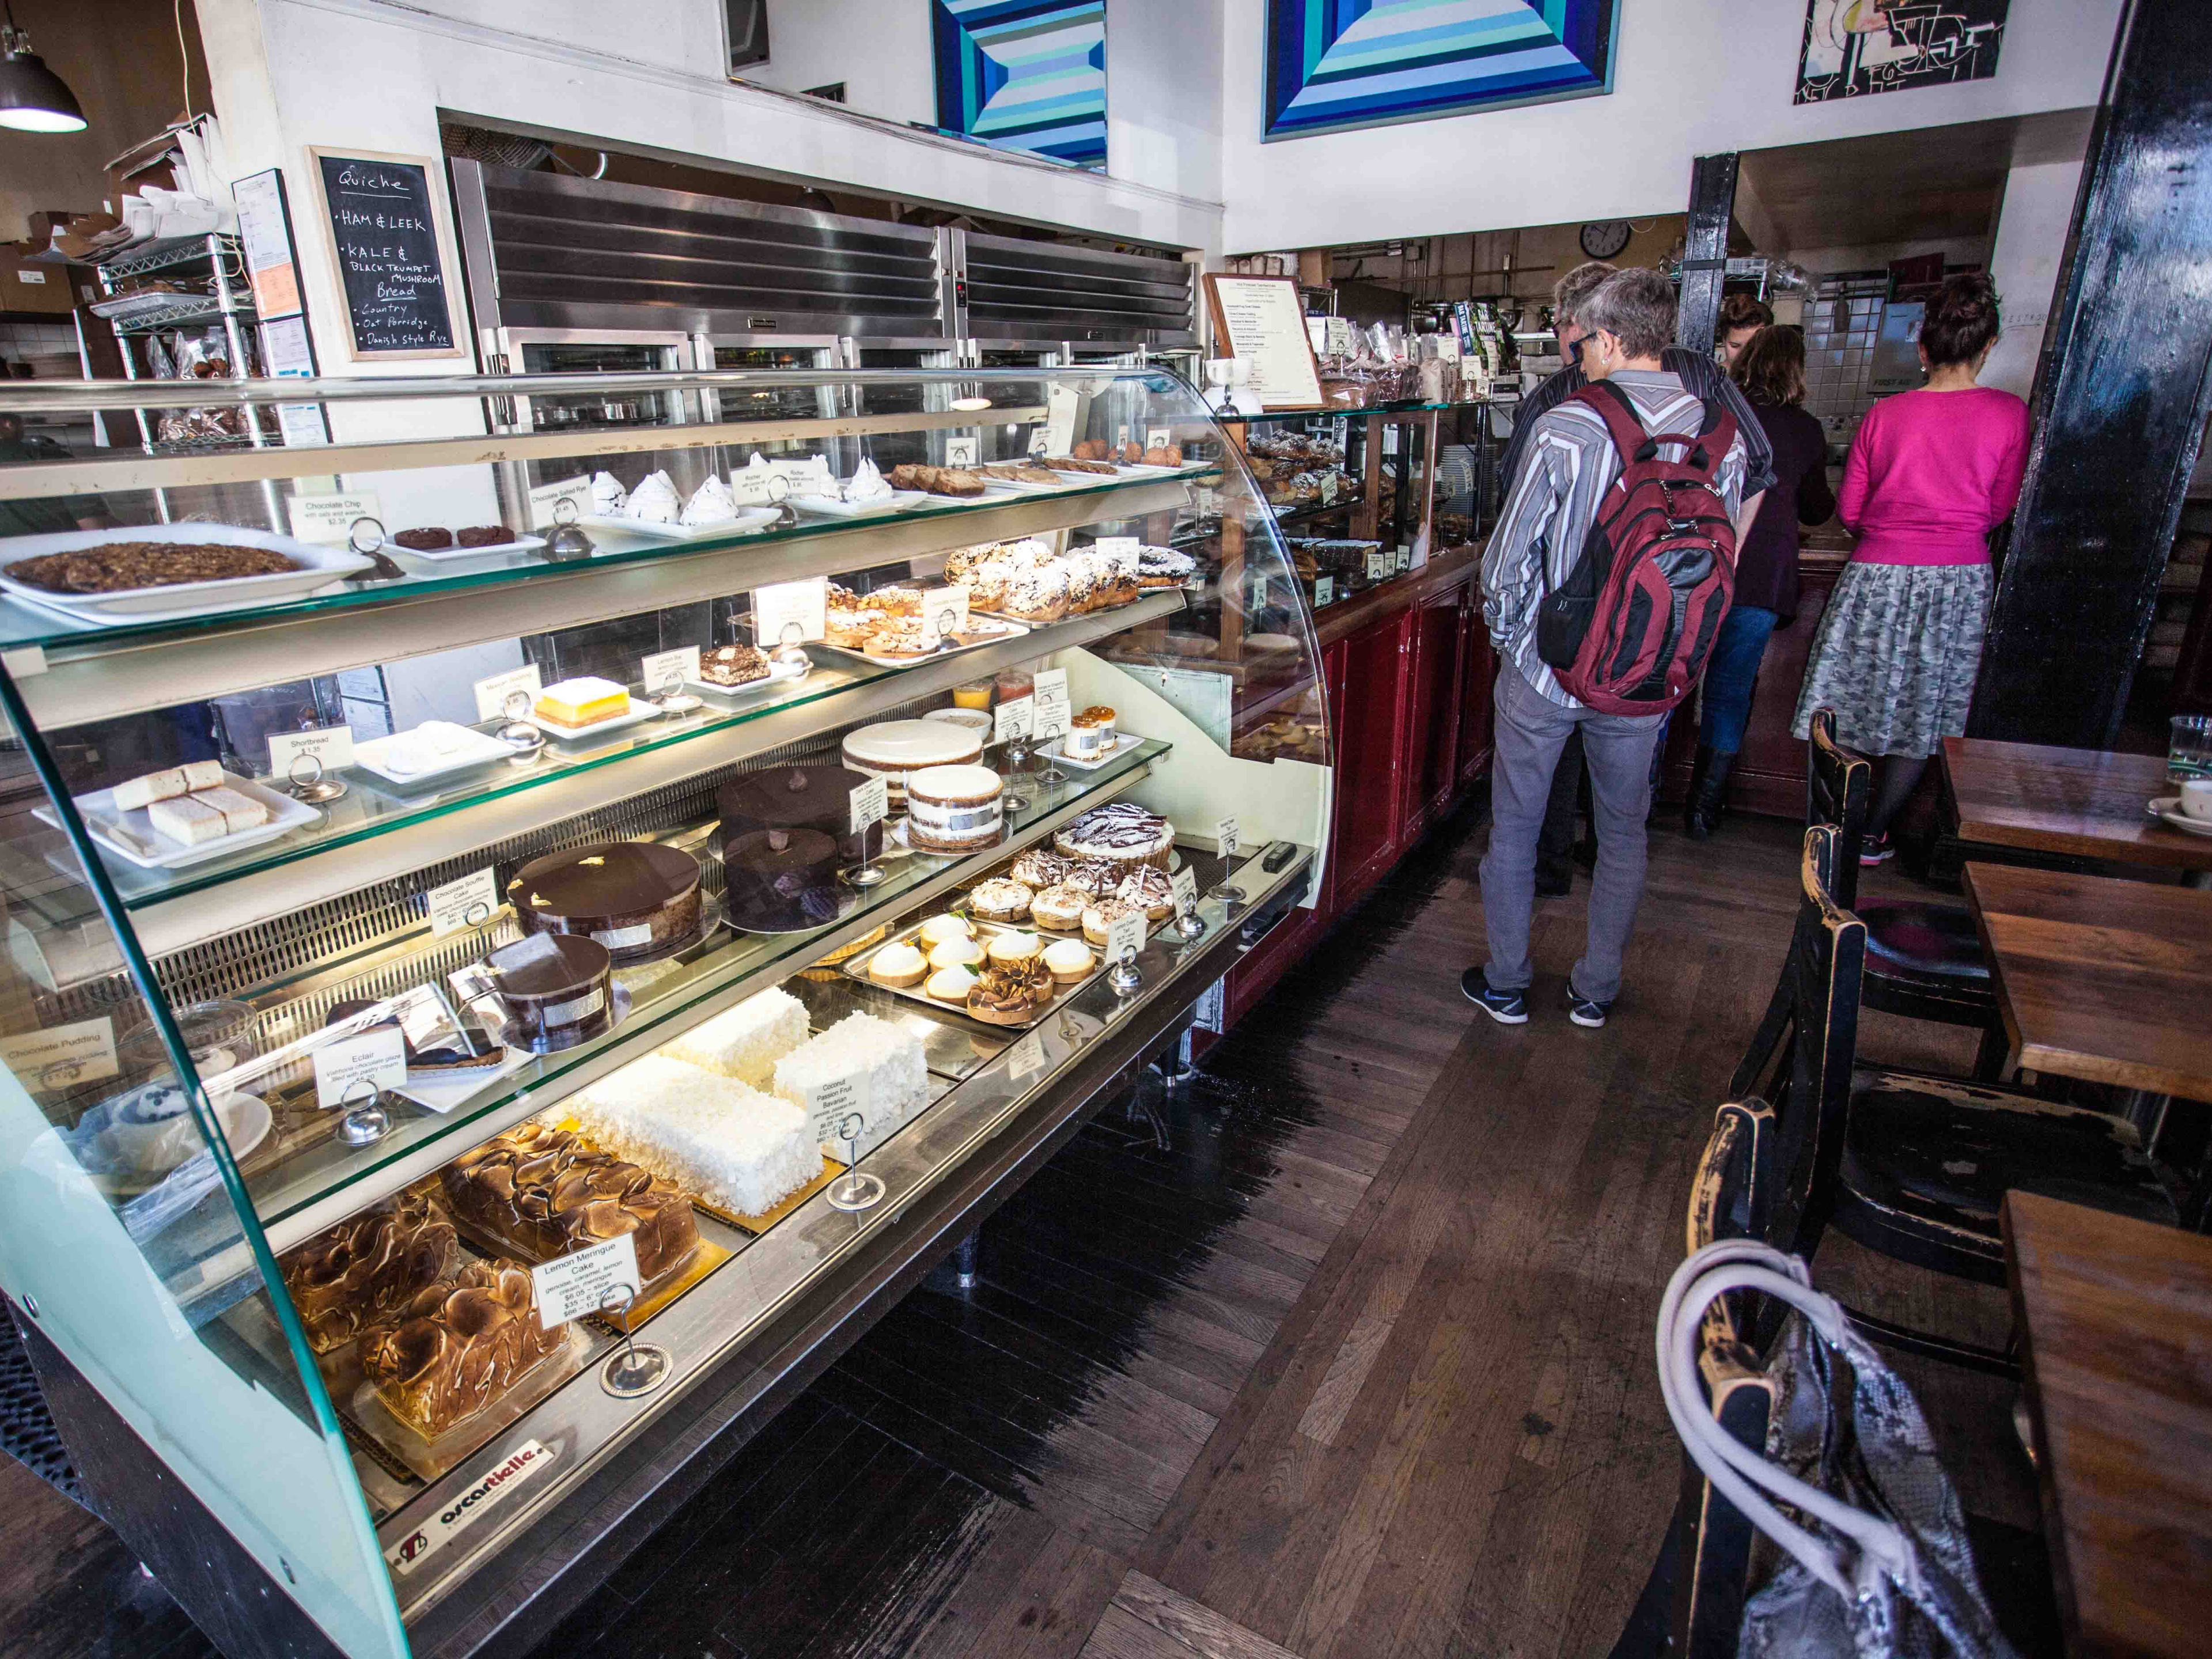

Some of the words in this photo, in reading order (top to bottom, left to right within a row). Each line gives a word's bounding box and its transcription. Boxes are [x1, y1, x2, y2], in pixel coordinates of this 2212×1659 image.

[339, 171, 410, 191] Quiche
[342, 210, 371, 225] HAM
[377, 213, 385, 229] &
[390, 216, 426, 232] LEEK
[348, 243, 392, 258] KALE
[399, 246, 408, 262] &
[350, 262, 384, 272] BLACK
[386, 264, 431, 272] TRUMPET
[392, 274, 441, 285] MUSHROOM
[377, 281, 416, 297] Bread
[362, 303, 407, 318] Country
[363, 319, 381, 328] Oat
[388, 316, 428, 329] Porridge
[367, 332, 397, 344] Danish
[430, 330, 449, 344] Rye
[532, 493, 558, 503] Chocolate
[559, 487, 575, 495] Salted
[576, 485, 586, 493] Rye
[290, 736, 329, 748] Shortbread
[435, 884, 464, 899] Chocolate
[465, 876, 484, 887] Souffle
[453, 890, 469, 899] Cake
[9, 1044, 59, 1059] Chocolate
[62, 1033, 100, 1047] Pudding
[352, 1051, 374, 1063] Eclair
[385, 1054, 402, 1063] glaze
[360, 1066, 378, 1076] pastry
[823, 1079, 846, 1091] Coconut
[817, 1090, 839, 1101] Passion
[840, 1086, 852, 1094] Fruit
[823, 1096, 847, 1108] Bavarian
[544, 1260, 574, 1275] Lemon
[577, 1243, 616, 1262] Meringue
[571, 1262, 594, 1274] Cake
[603, 1260, 623, 1271] lemon
[583, 1271, 612, 1287] meringue
[593, 1281, 609, 1290] slice
[600, 1294, 616, 1302] ake
[565, 1300, 578, 1309] $35
[441, 1450, 536, 1524] oscartielle
